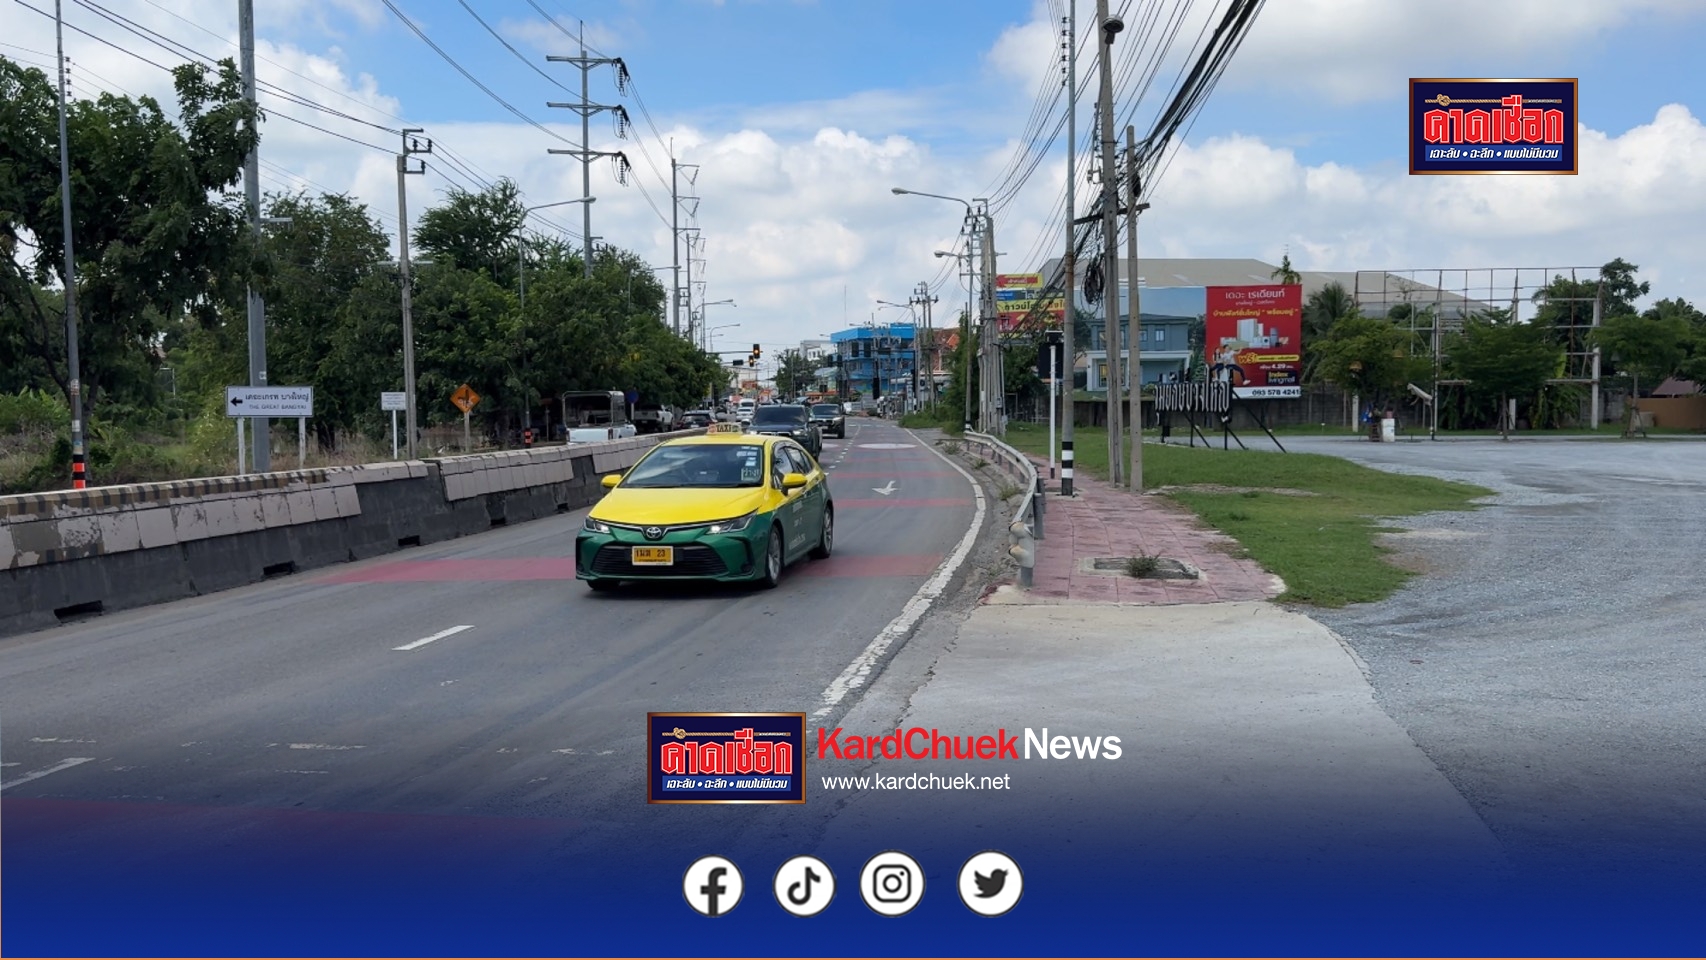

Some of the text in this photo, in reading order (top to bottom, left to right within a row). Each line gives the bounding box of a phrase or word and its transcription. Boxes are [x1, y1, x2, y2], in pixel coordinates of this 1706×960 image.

[1248, 288, 1285, 299] เรเดียนท์
[281, 391, 309, 402] บางใหญ่
